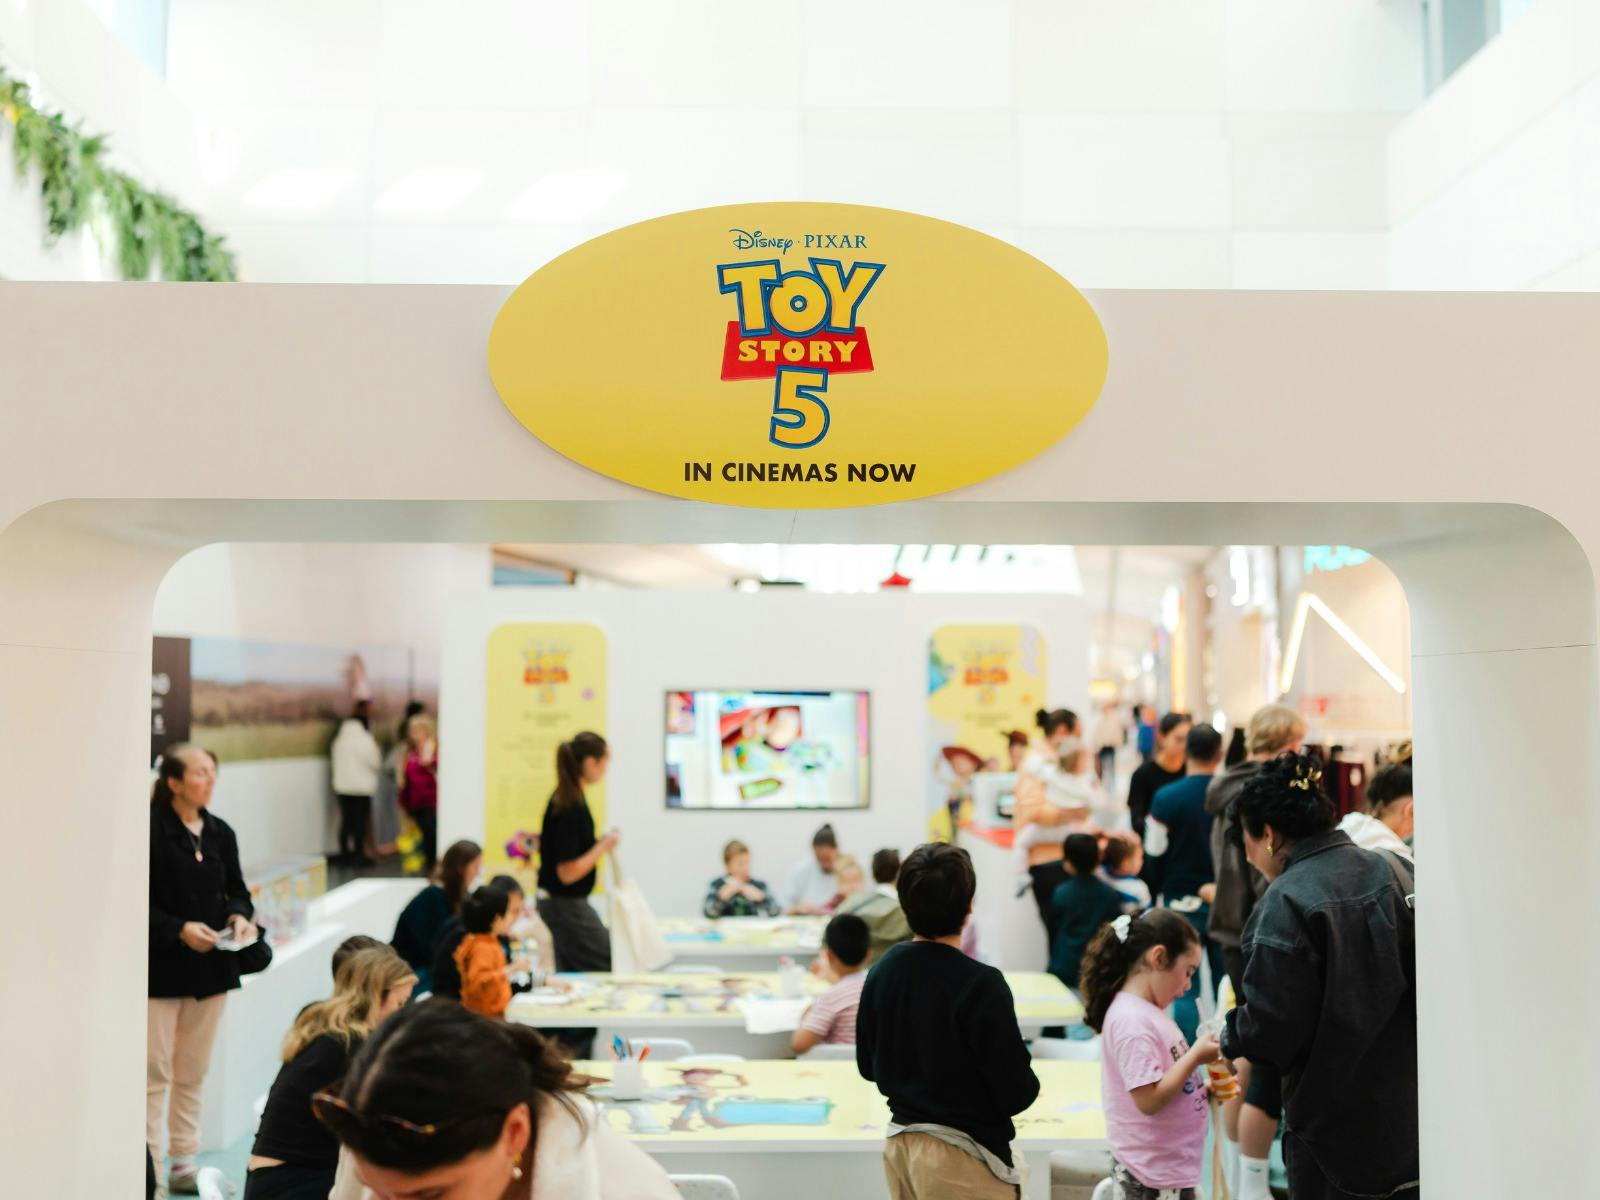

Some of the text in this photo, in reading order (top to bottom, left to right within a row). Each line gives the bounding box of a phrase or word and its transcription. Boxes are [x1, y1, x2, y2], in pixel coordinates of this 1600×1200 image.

[729, 228, 868, 255] Disney PIXAR
[717, 257, 886, 338] TOY
[738, 340, 858, 363] STORY
[769, 365, 831, 450] 5
[684, 462, 917, 483] IN CINEMAS NOW
